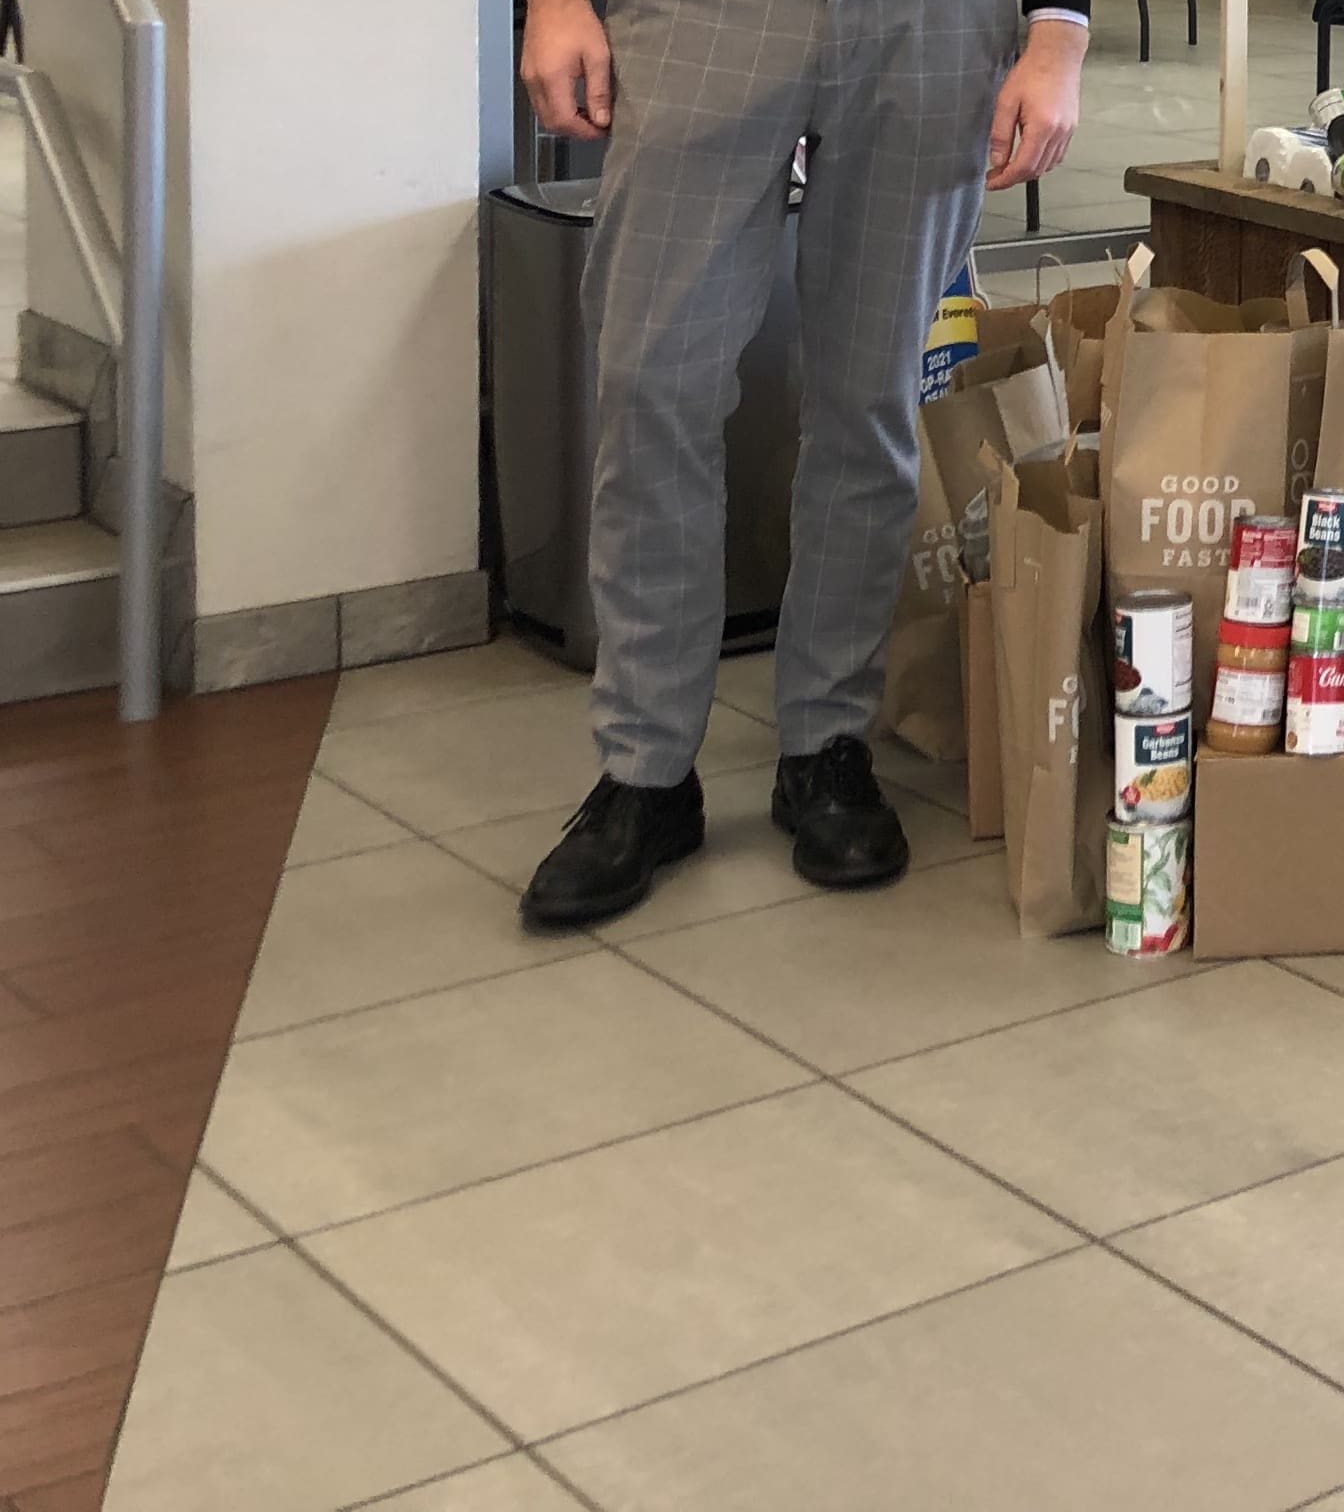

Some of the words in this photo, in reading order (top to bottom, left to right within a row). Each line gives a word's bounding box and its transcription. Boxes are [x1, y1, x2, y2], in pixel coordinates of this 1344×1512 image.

[927, 350, 952, 371] 2021
[1161, 475, 1240, 495] GOOD
[1312, 513, 1341, 529] Black
[1309, 528, 1341, 542] Beans
[1142, 735, 1185, 751] Garbanzo
[1150, 746, 1180, 762] Beans
